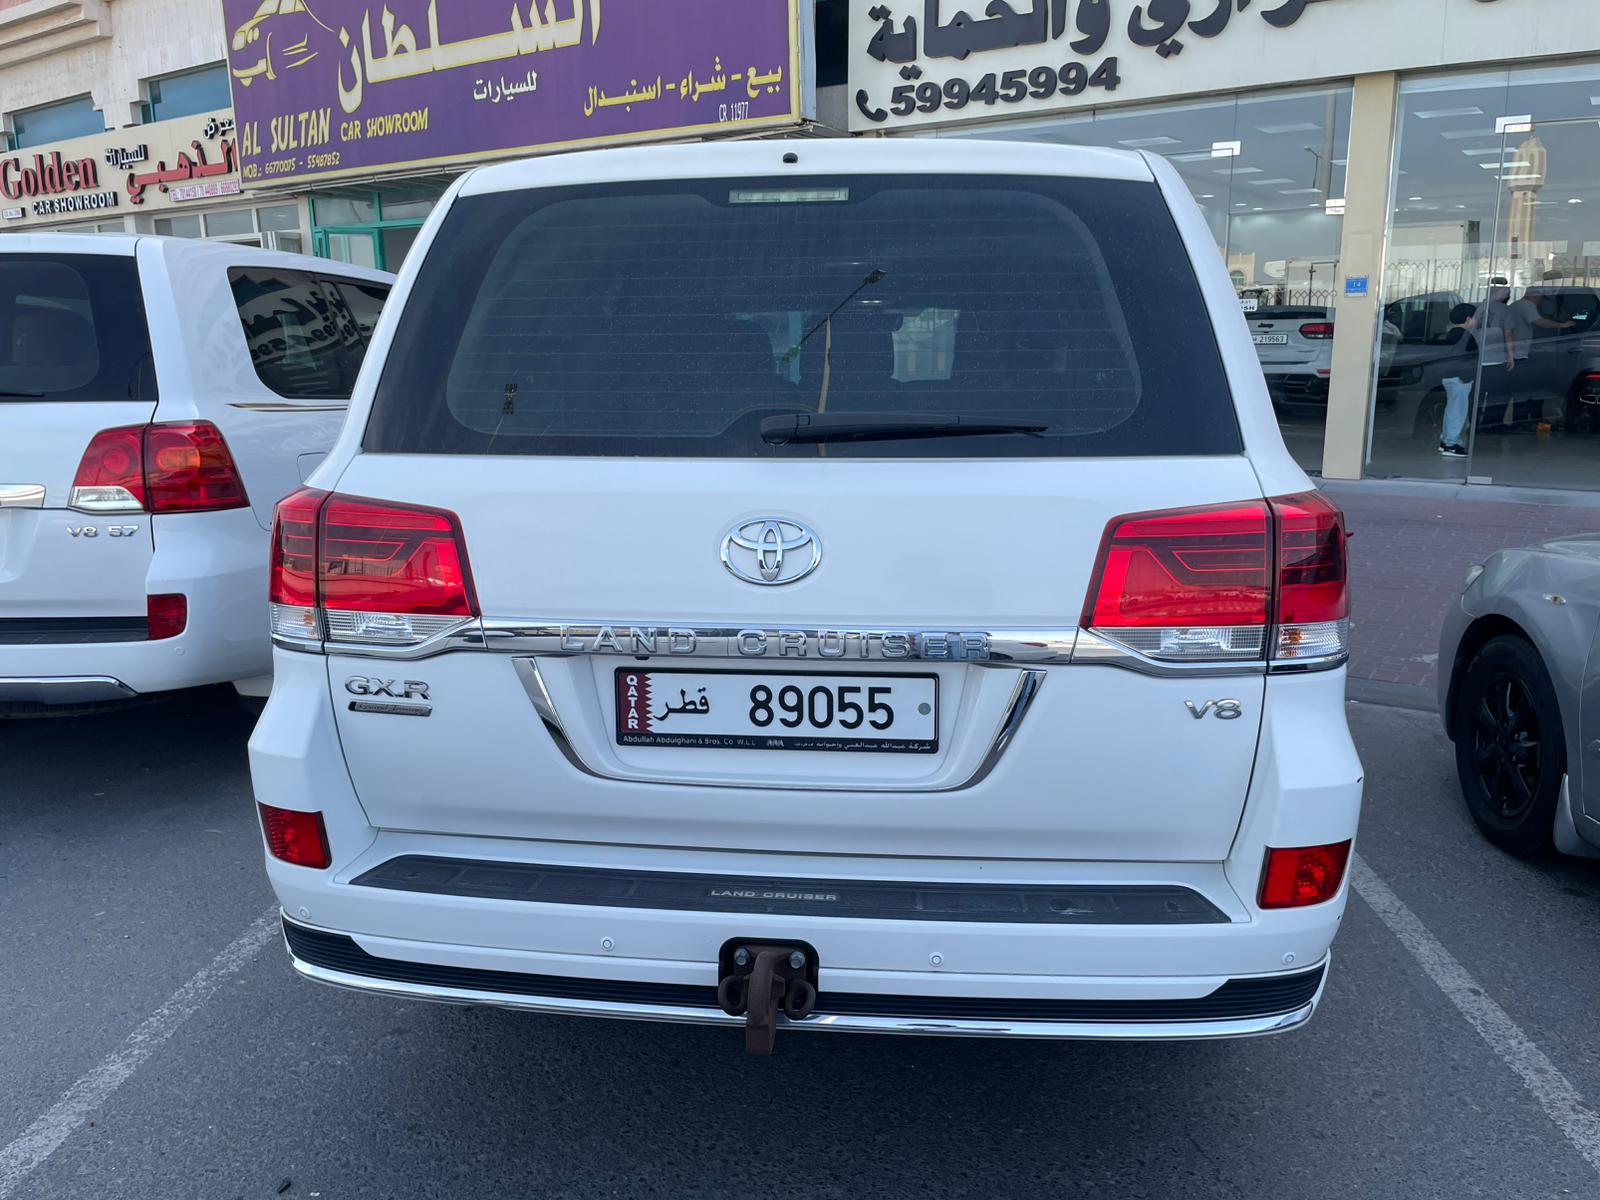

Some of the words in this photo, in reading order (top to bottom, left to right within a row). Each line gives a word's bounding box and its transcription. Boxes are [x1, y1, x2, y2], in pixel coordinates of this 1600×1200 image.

[473, 69, 538, 103] للسيارات
[680, 56, 727, 102] شراء
[747, 64, 782, 98] بيع
[890, 57, 1121, 116] 59945994
[731, 101, 749, 120] 11977
[242, 122, 261, 157] AL
[270, 108, 331, 154] SULTAN
[340, 121, 361, 142] CAR
[366, 107, 429, 138] SHOWROOM
[0, 151, 100, 200] Golden
[32, 200, 52, 215] CAR
[54, 191, 118, 213] SHOWROOM
[67, 526, 99, 538] V8
[561, 625, 698, 653] LAND
[736, 628, 991, 660] CRUISER
[344, 675, 432, 700] GXR
[626, 675, 639, 729] QATAR
[653, 687, 710, 720] قطر
[749, 684, 895, 730] 89055
[1184, 698, 1242, 720] V8
[623, 735, 654, 743] Abdullah
[763, 892, 837, 900] CRUISER
